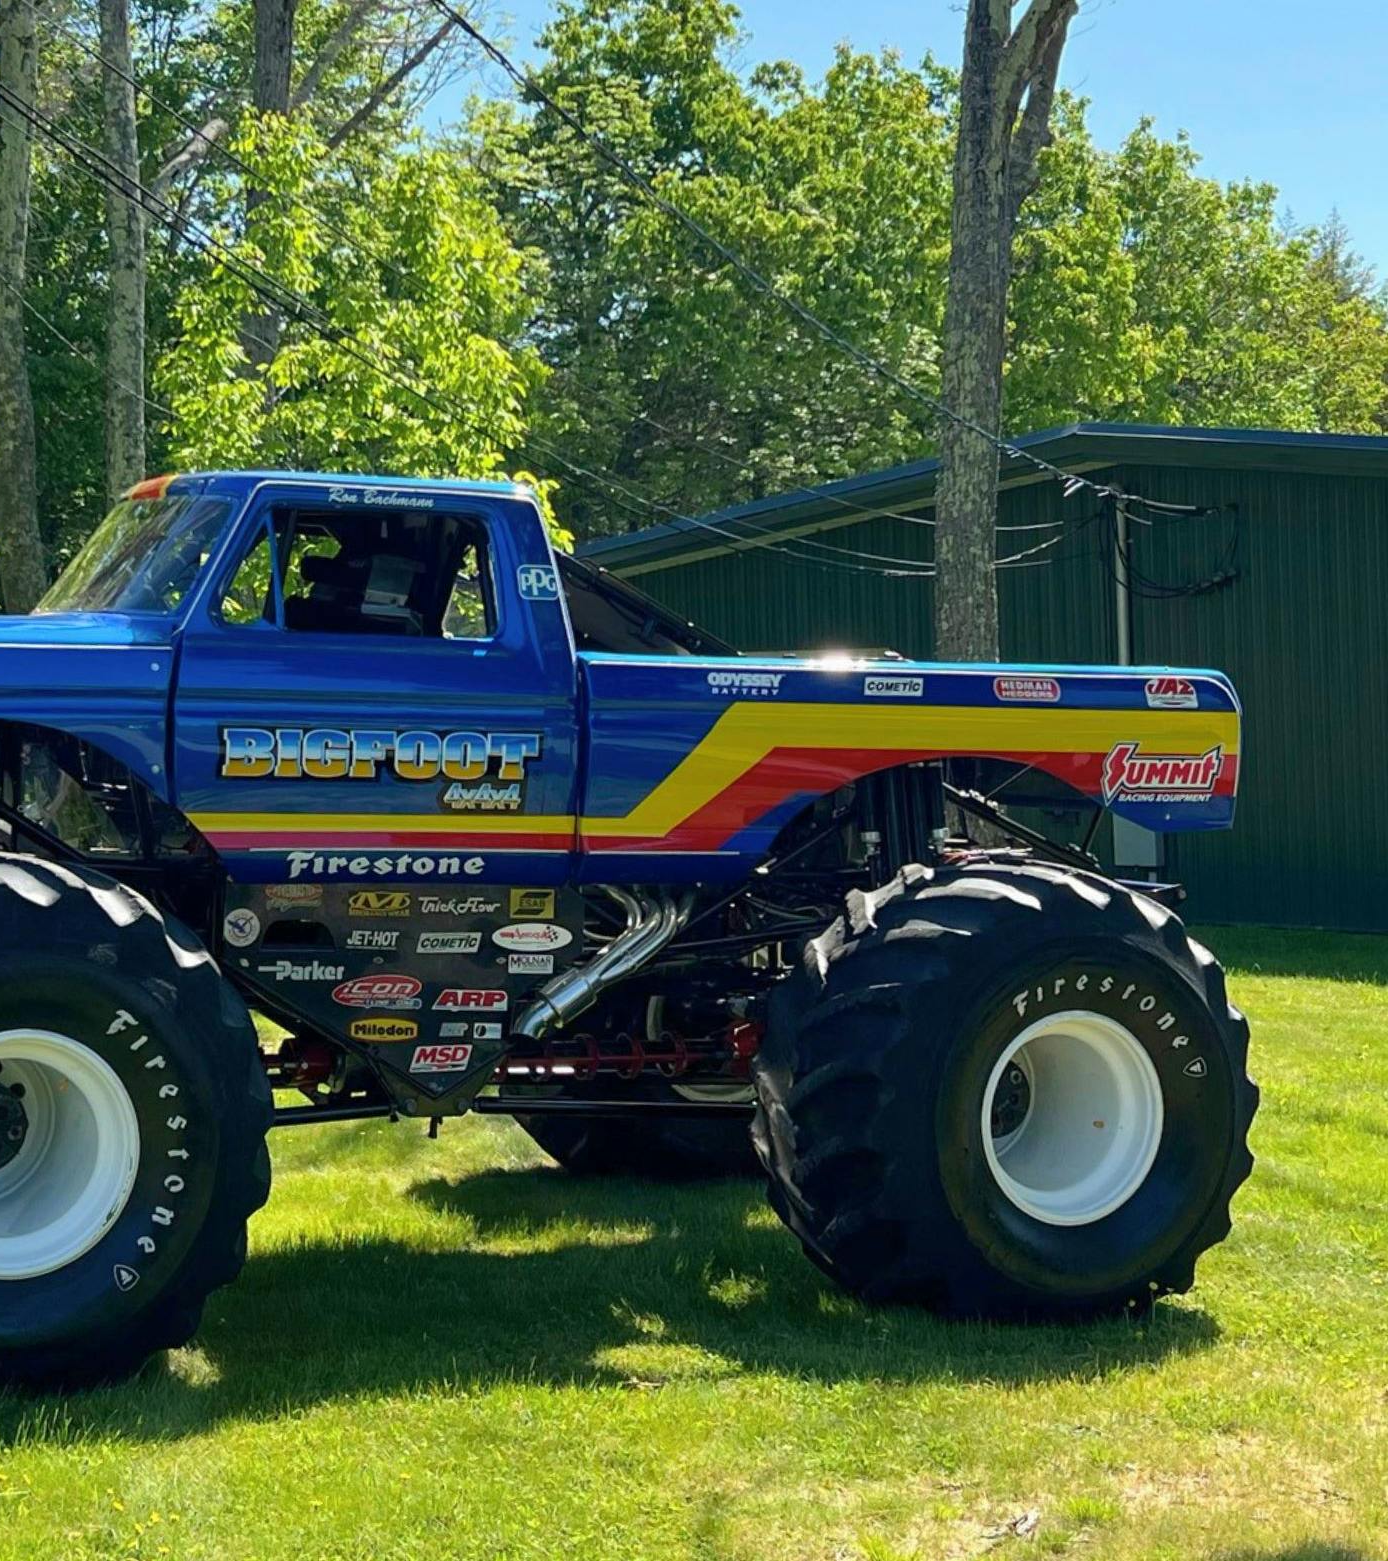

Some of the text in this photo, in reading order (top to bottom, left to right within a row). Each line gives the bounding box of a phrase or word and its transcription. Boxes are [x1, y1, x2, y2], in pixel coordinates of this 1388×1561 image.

[328, 487, 434, 507] Ron Bachmann
[520, 570, 557, 596] PPG
[707, 672, 782, 687] ODYSSEY
[1146, 678, 1195, 694] JAZ
[712, 687, 779, 695] BATTERY
[222, 728, 540, 781] BIGFOOT
[1118, 793, 1212, 802] RACING EQUIPMENT
[285, 851, 485, 878] Firestone
[347, 930, 399, 946] JET-HOT
[276, 960, 345, 981] Parker
[437, 992, 506, 1007] ARP
[1012, 974, 1190, 1049] Firestone
[354, 1024, 414, 1036] Milodon
[415, 1046, 468, 1064] MSD
[106, 1009, 190, 1253] Firestone
